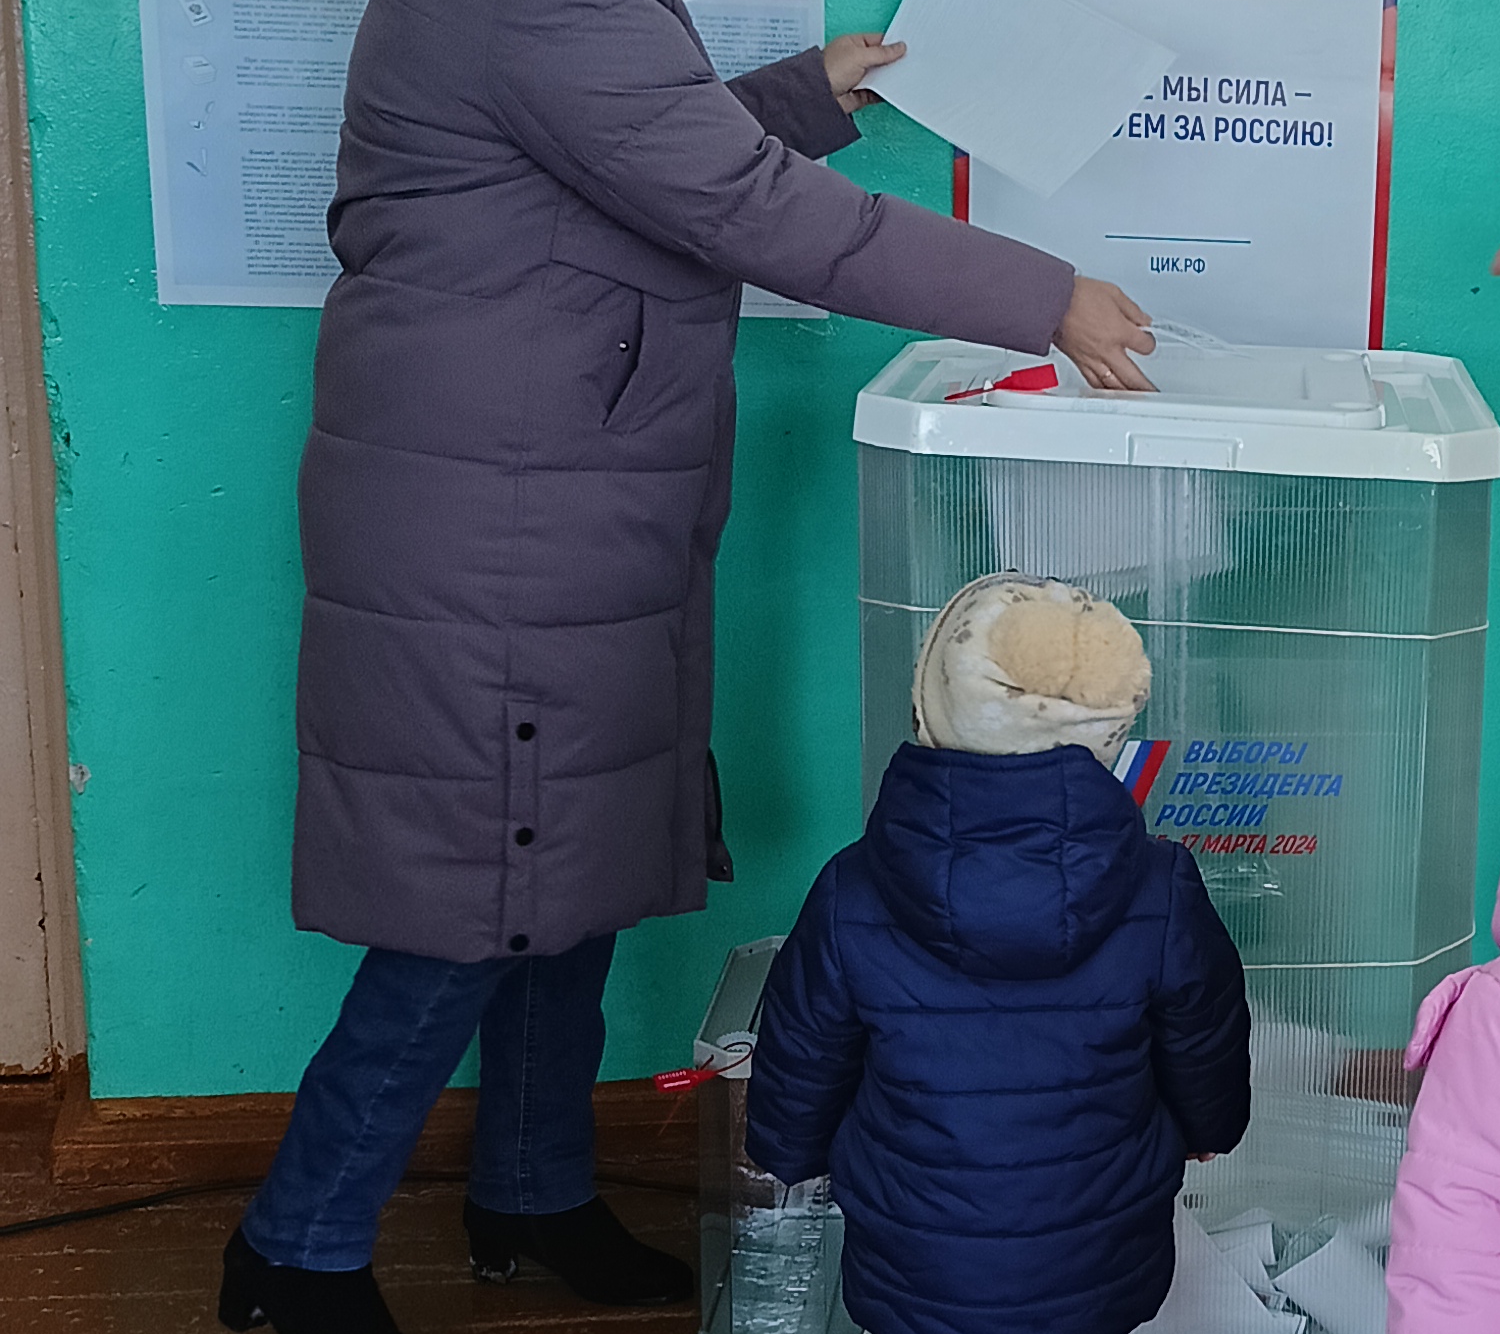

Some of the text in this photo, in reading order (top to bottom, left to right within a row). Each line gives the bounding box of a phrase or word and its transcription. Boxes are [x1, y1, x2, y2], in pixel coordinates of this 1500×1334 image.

[1162, 75, 1208, 103] МЫ
[1218, 78, 1287, 107] СИЛА
[1173, 115, 1206, 141] ЗА
[1214, 117, 1333, 147] РОССИЮ!
[1150, 256, 1206, 275] ЦИК.РФ
[1183, 740, 1308, 764] ВЫБОРЫ
[1169, 772, 1343, 799] ПРЕЗИДЕНТА
[1154, 804, 1268, 827] РОССИИ
[1200, 834, 1267, 854] МАРТА
[1270, 835, 1318, 855] 2024
